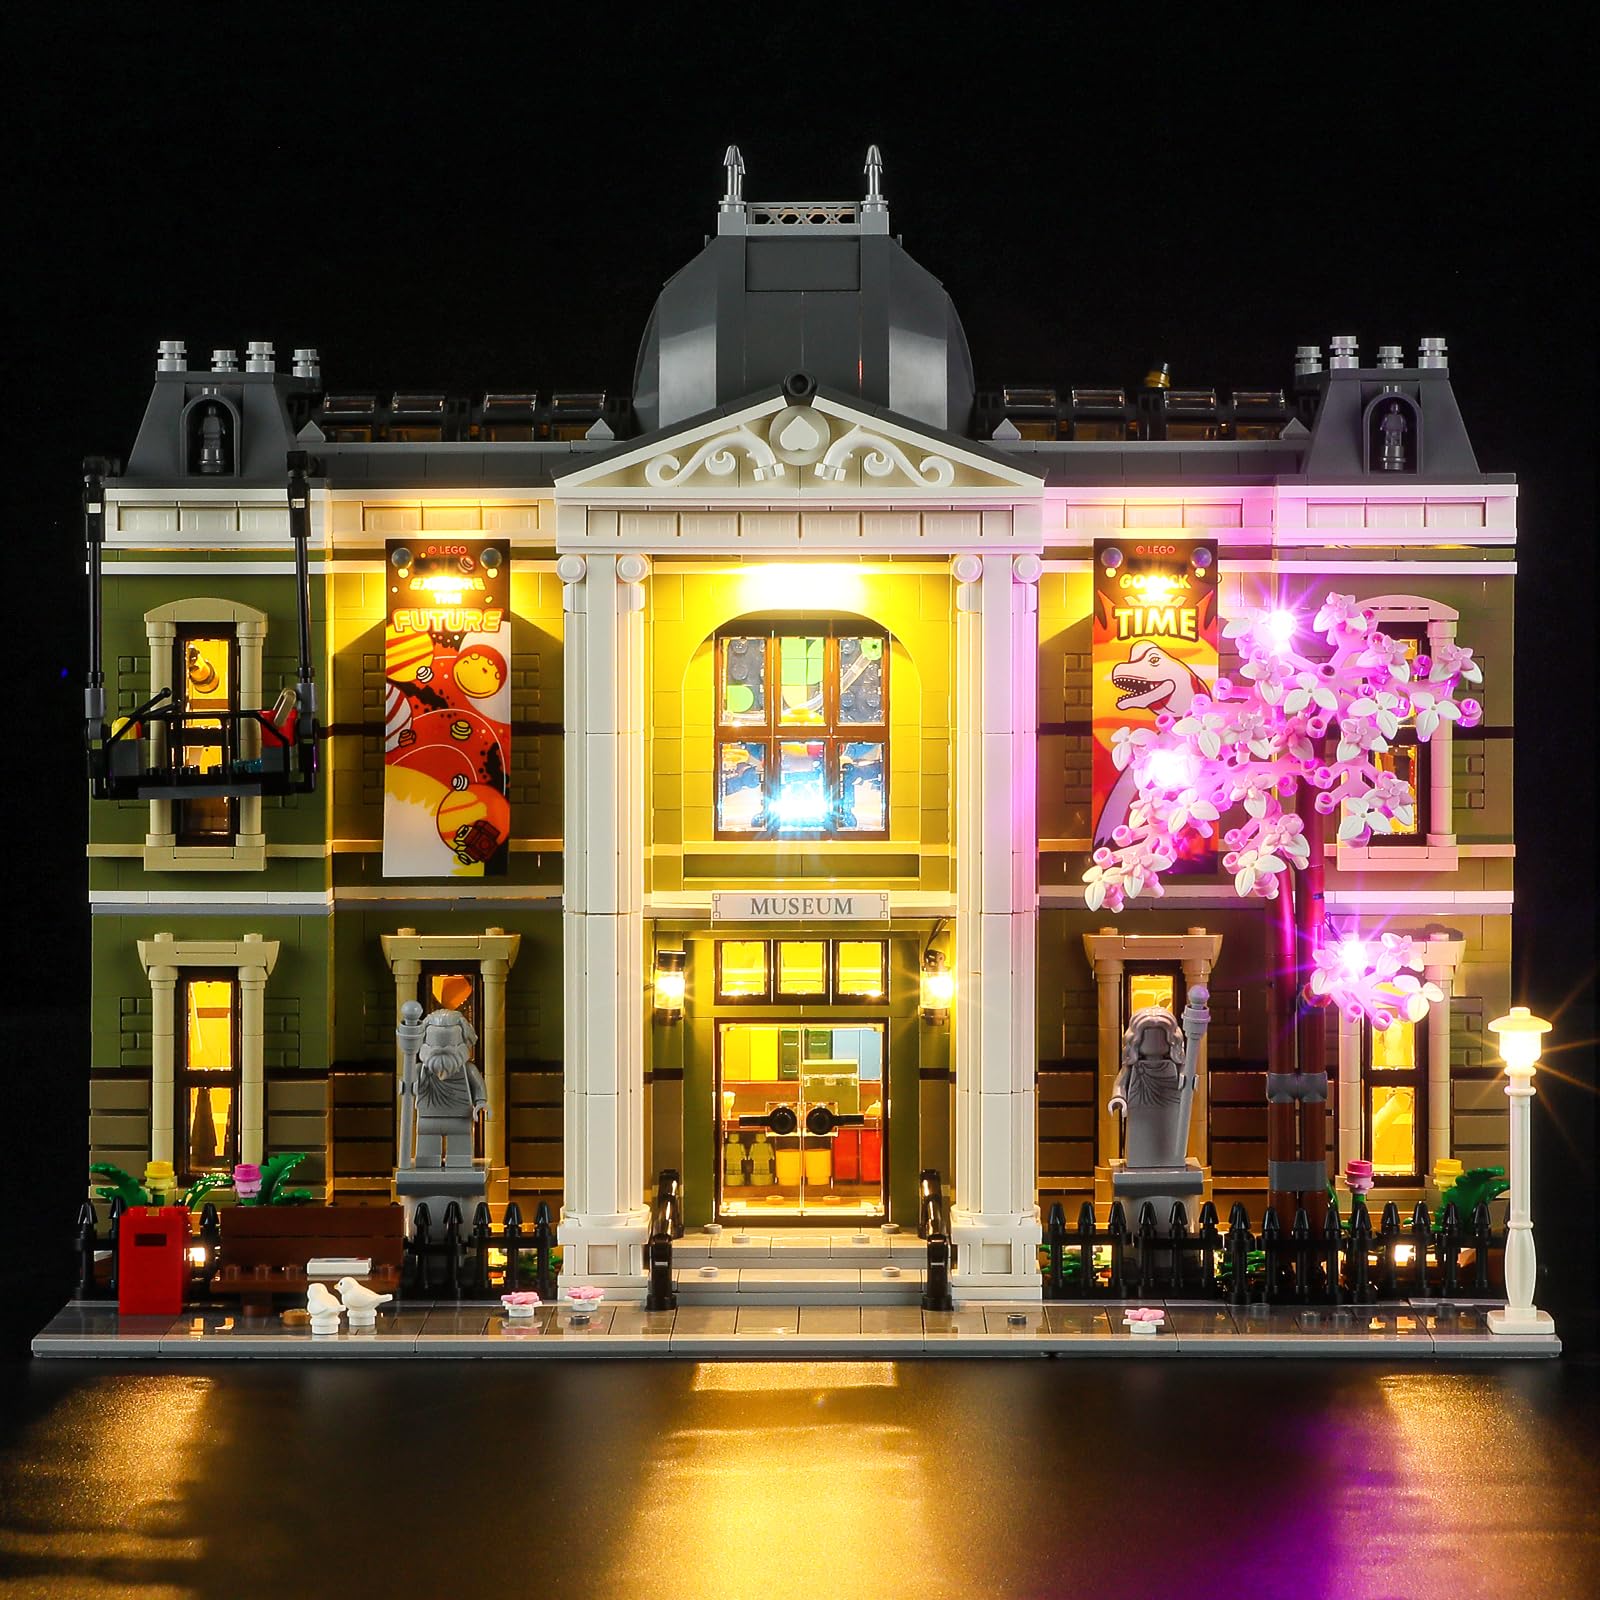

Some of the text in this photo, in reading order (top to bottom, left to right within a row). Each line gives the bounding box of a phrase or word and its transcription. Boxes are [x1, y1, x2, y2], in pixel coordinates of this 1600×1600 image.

[439, 545, 468, 555] LEGO
[1147, 545, 1176, 555] LEGO
[392, 609, 504, 633] FUTURE
[1114, 608, 1197, 640] TIME
[750, 897, 854, 915] MUSEUM
